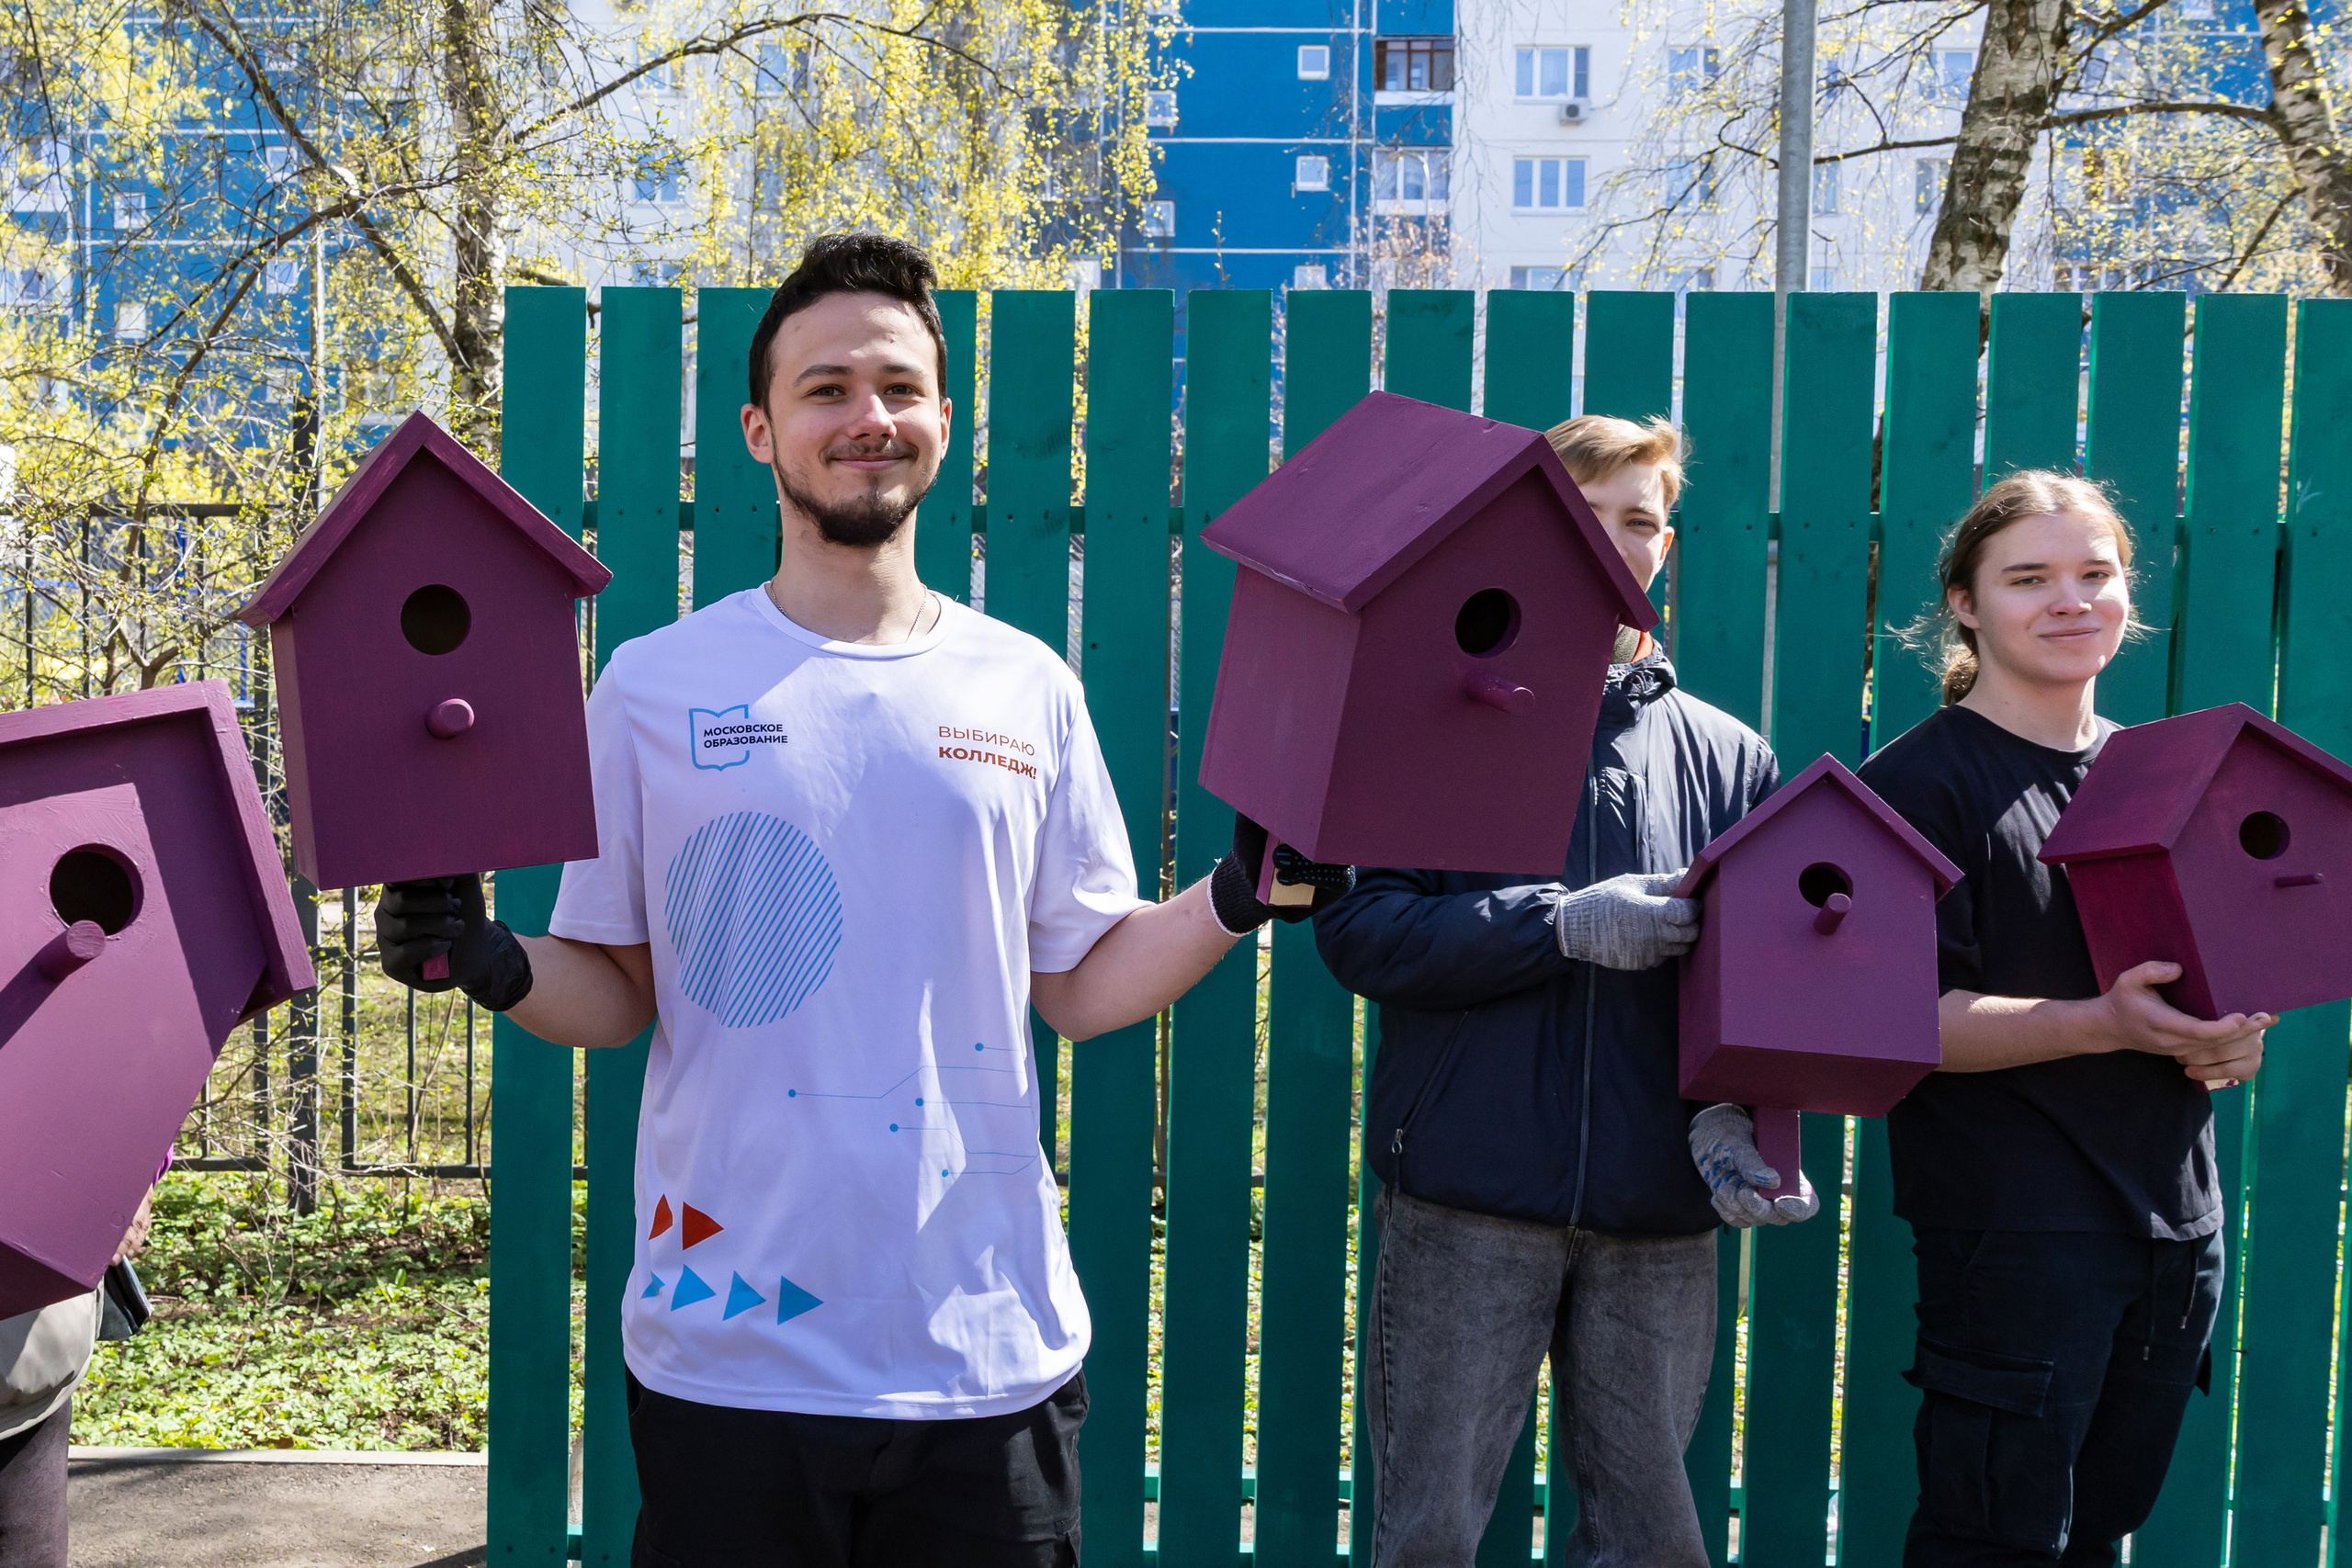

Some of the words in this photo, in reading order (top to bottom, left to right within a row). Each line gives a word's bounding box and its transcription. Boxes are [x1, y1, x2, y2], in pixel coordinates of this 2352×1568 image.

[704, 724, 783, 737] МОСКОВСКОЕ
[939, 726, 1035, 756] ВЫБИРАЮ
[704, 735, 788, 749] ОБРАЗОВАНИЕ
[939, 746, 1037, 780] КОЛЛЕДЖ!
